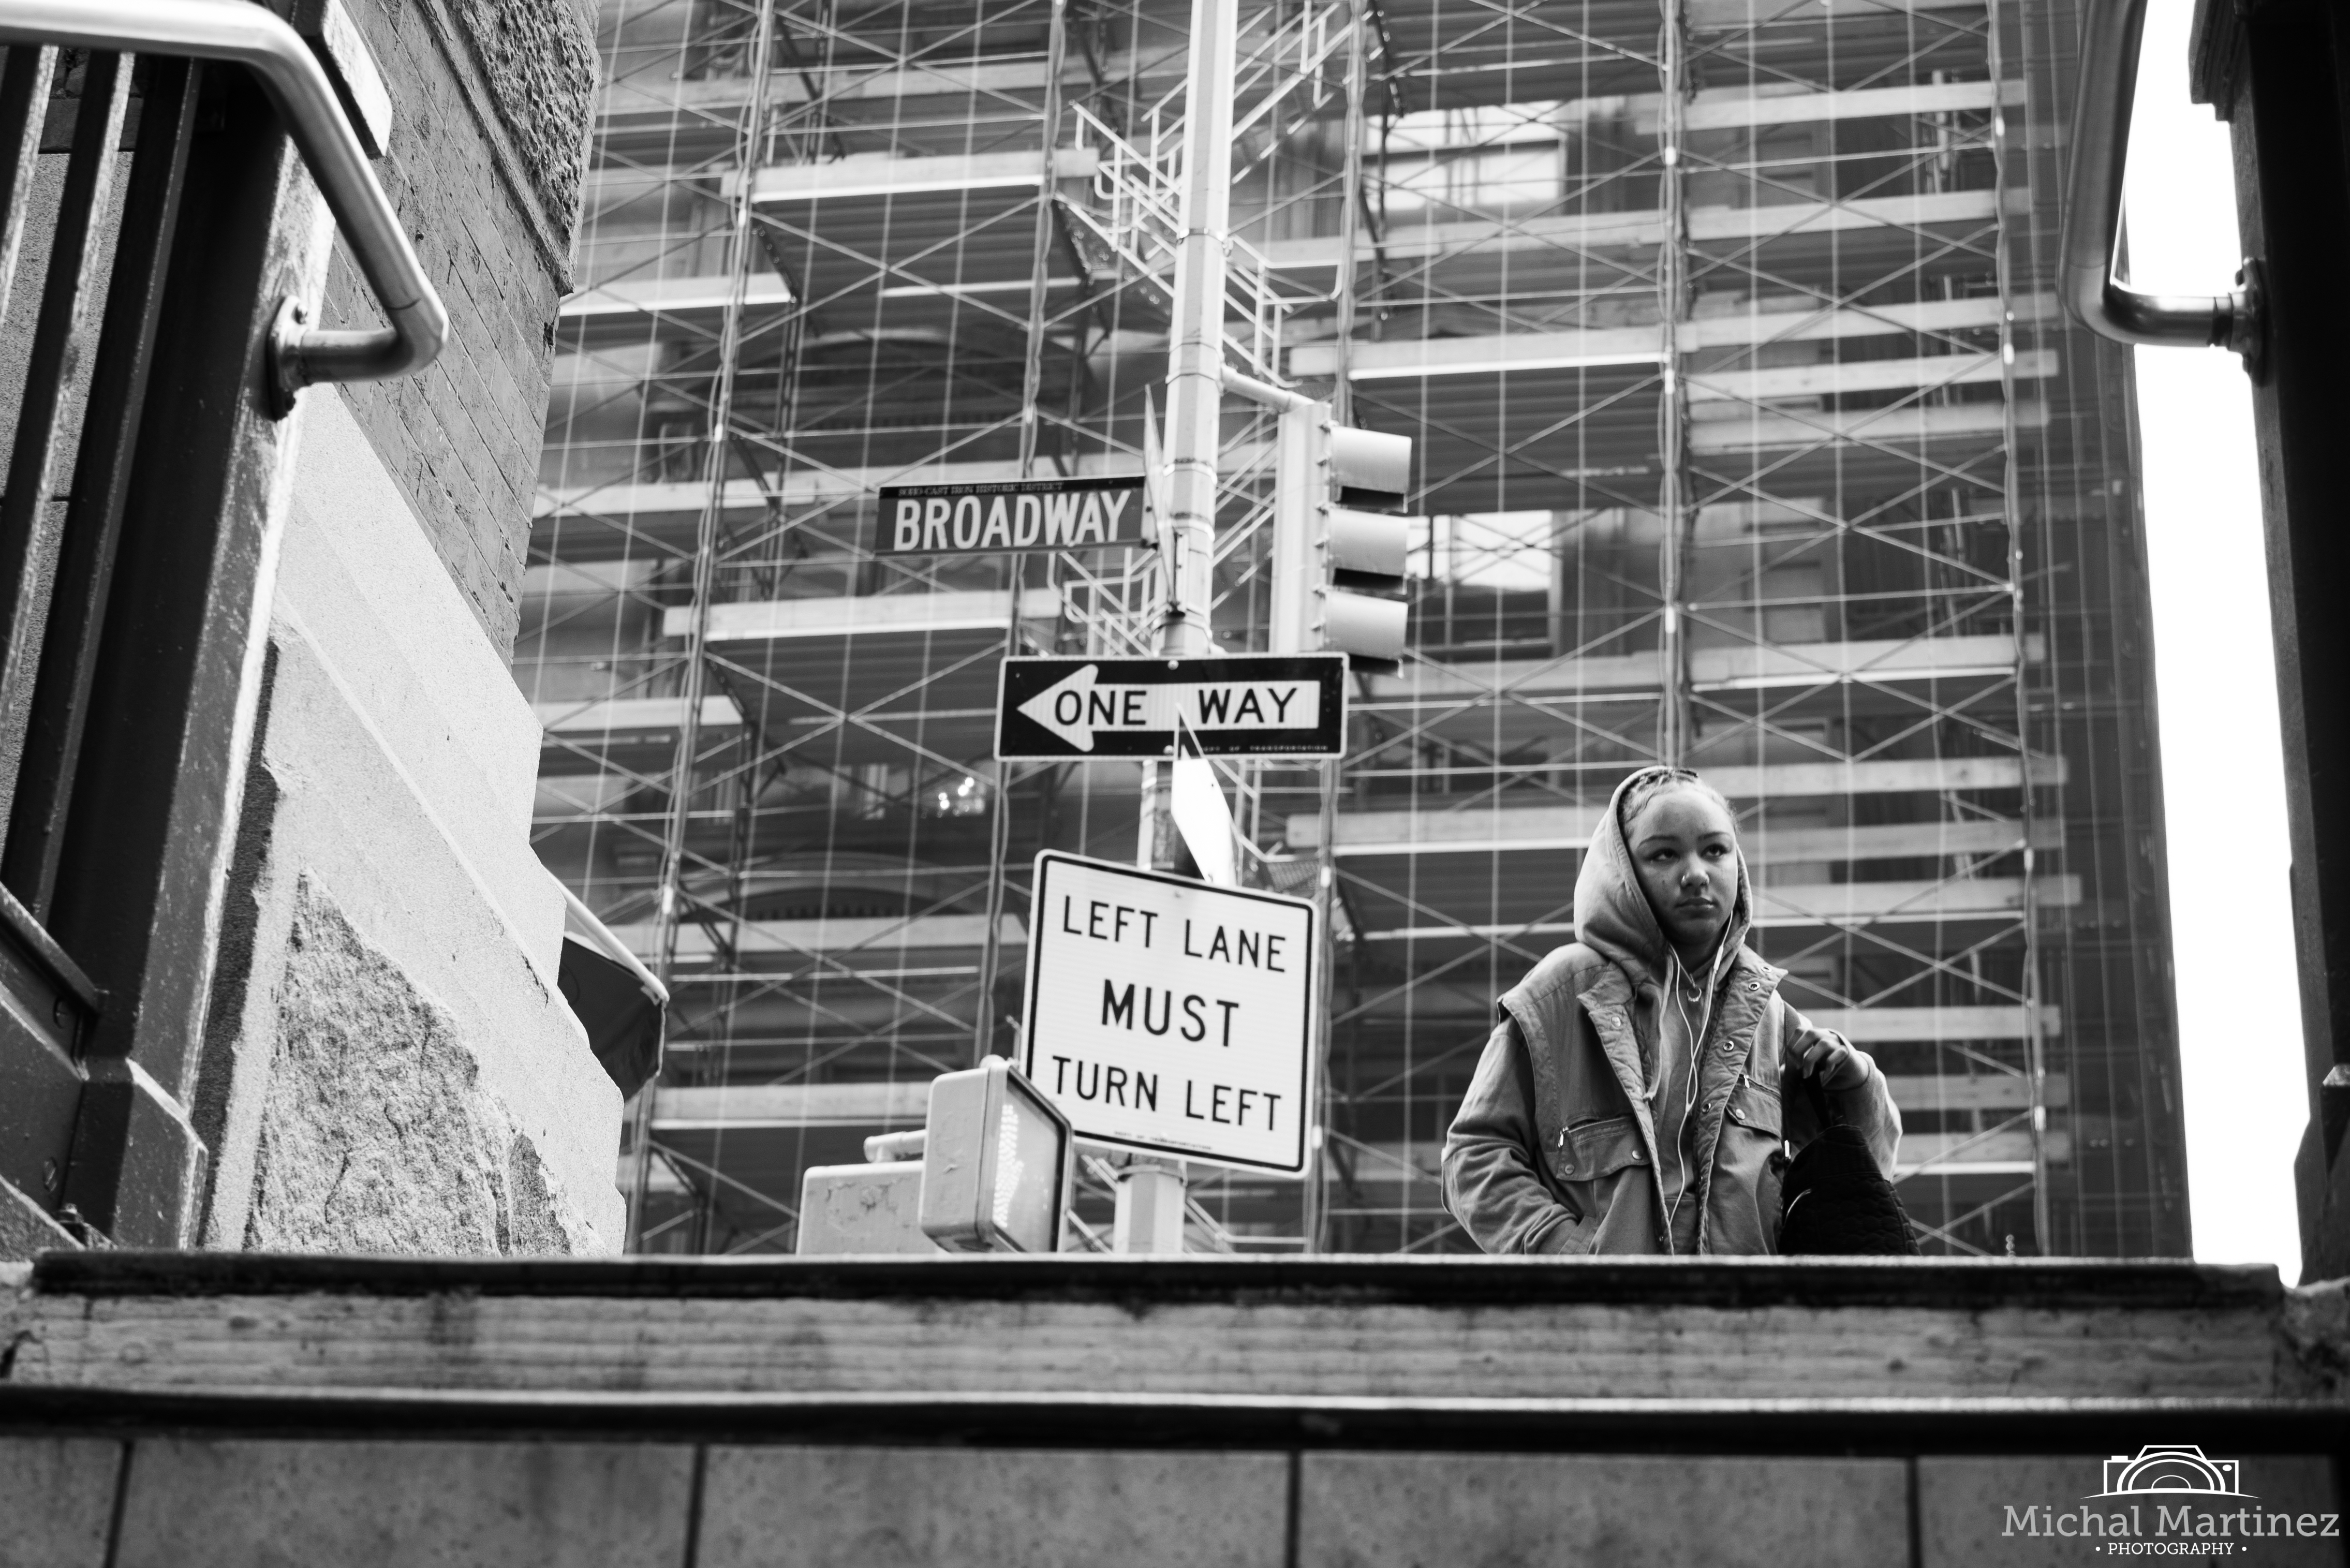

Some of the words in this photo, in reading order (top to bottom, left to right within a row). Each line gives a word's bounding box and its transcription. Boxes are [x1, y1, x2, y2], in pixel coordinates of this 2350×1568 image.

[894, 490, 1131, 552] BROADWAY
[1054, 689, 1147, 727] ONE
[1198, 687, 1297, 724] WAY
[1063, 895, 1159, 949] LEFT
[1184, 919, 1286, 973] LANE
[1101, 979, 1239, 1047] MUST
[1052, 1055, 1158, 1112] TURN
[1185, 1079, 1281, 1131] LEFT
